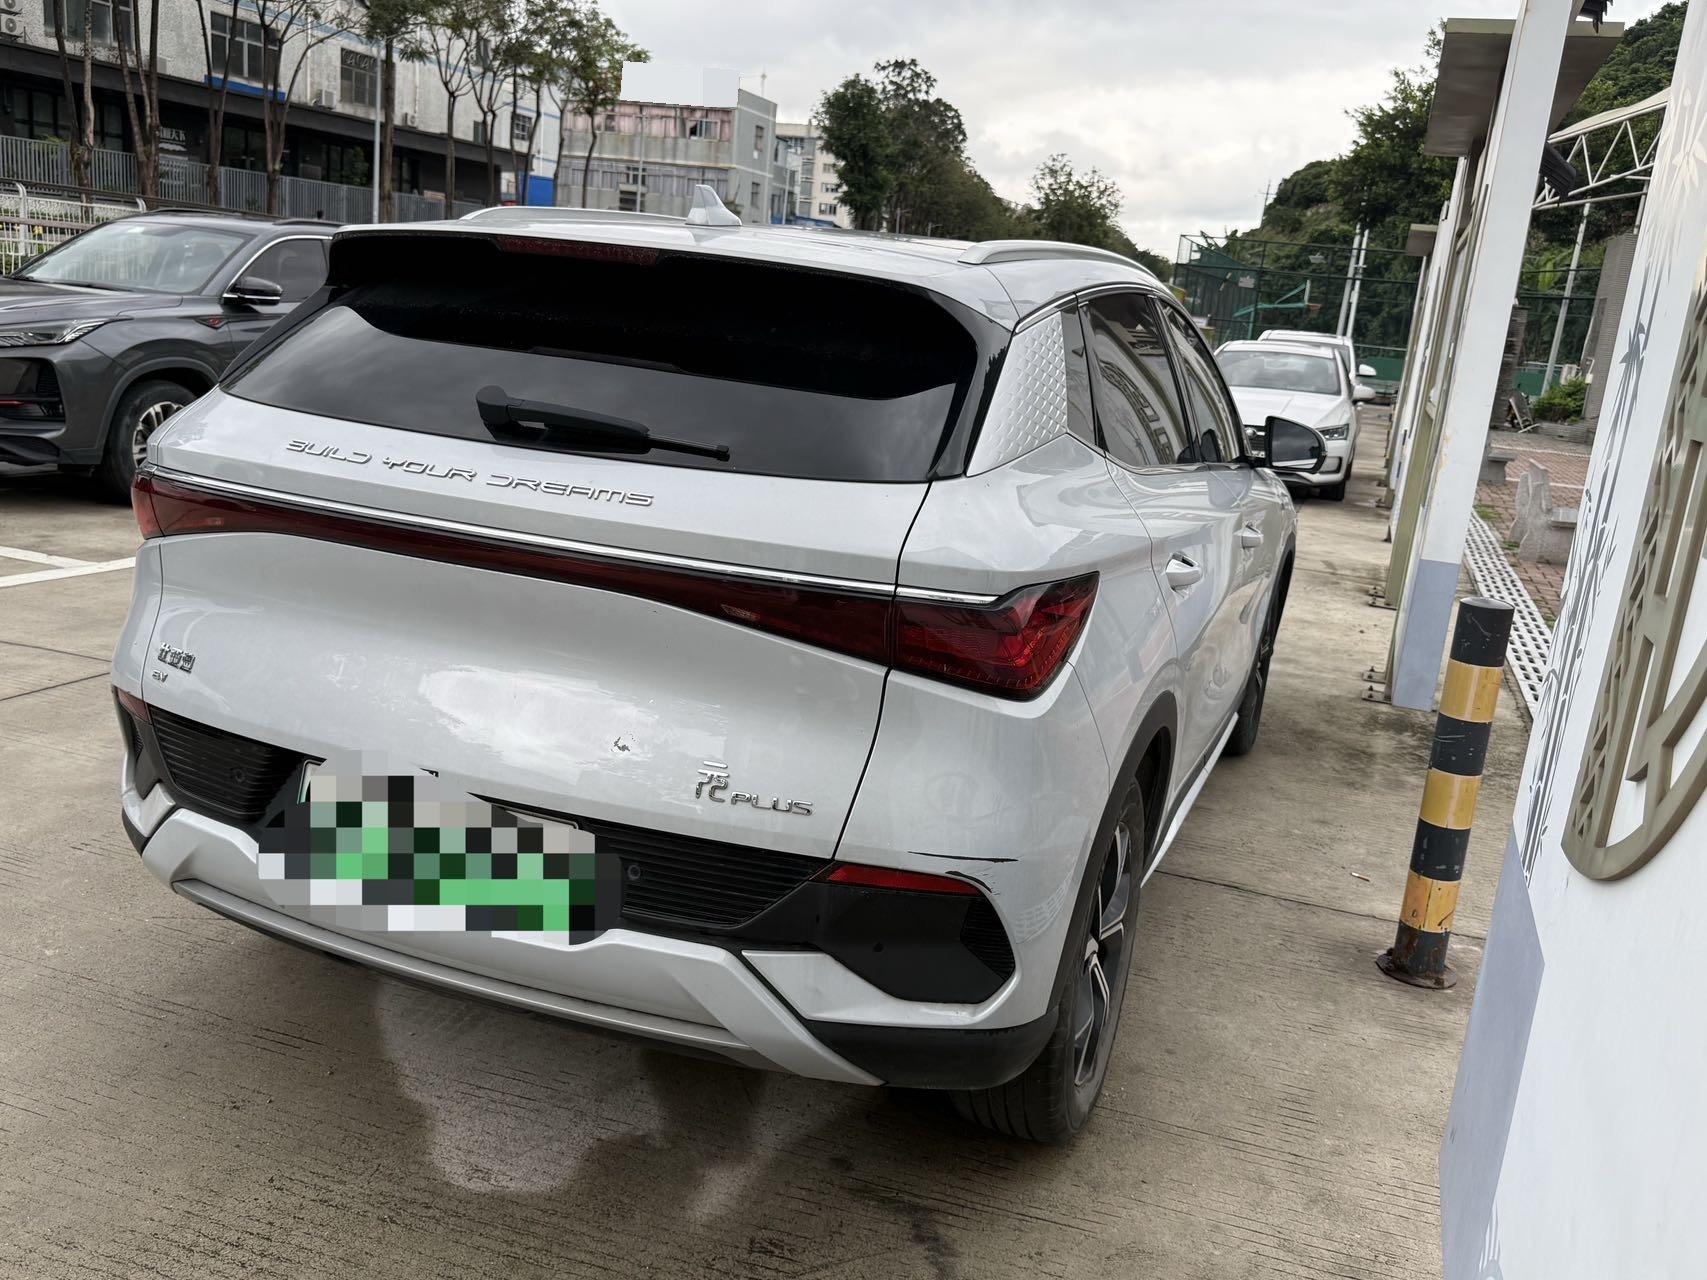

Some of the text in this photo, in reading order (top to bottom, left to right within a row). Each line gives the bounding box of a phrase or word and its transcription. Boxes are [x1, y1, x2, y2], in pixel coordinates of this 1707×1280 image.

[286, 439, 654, 507] BUILD YOUR DREAMS
[730, 791, 813, 816] PLUS
